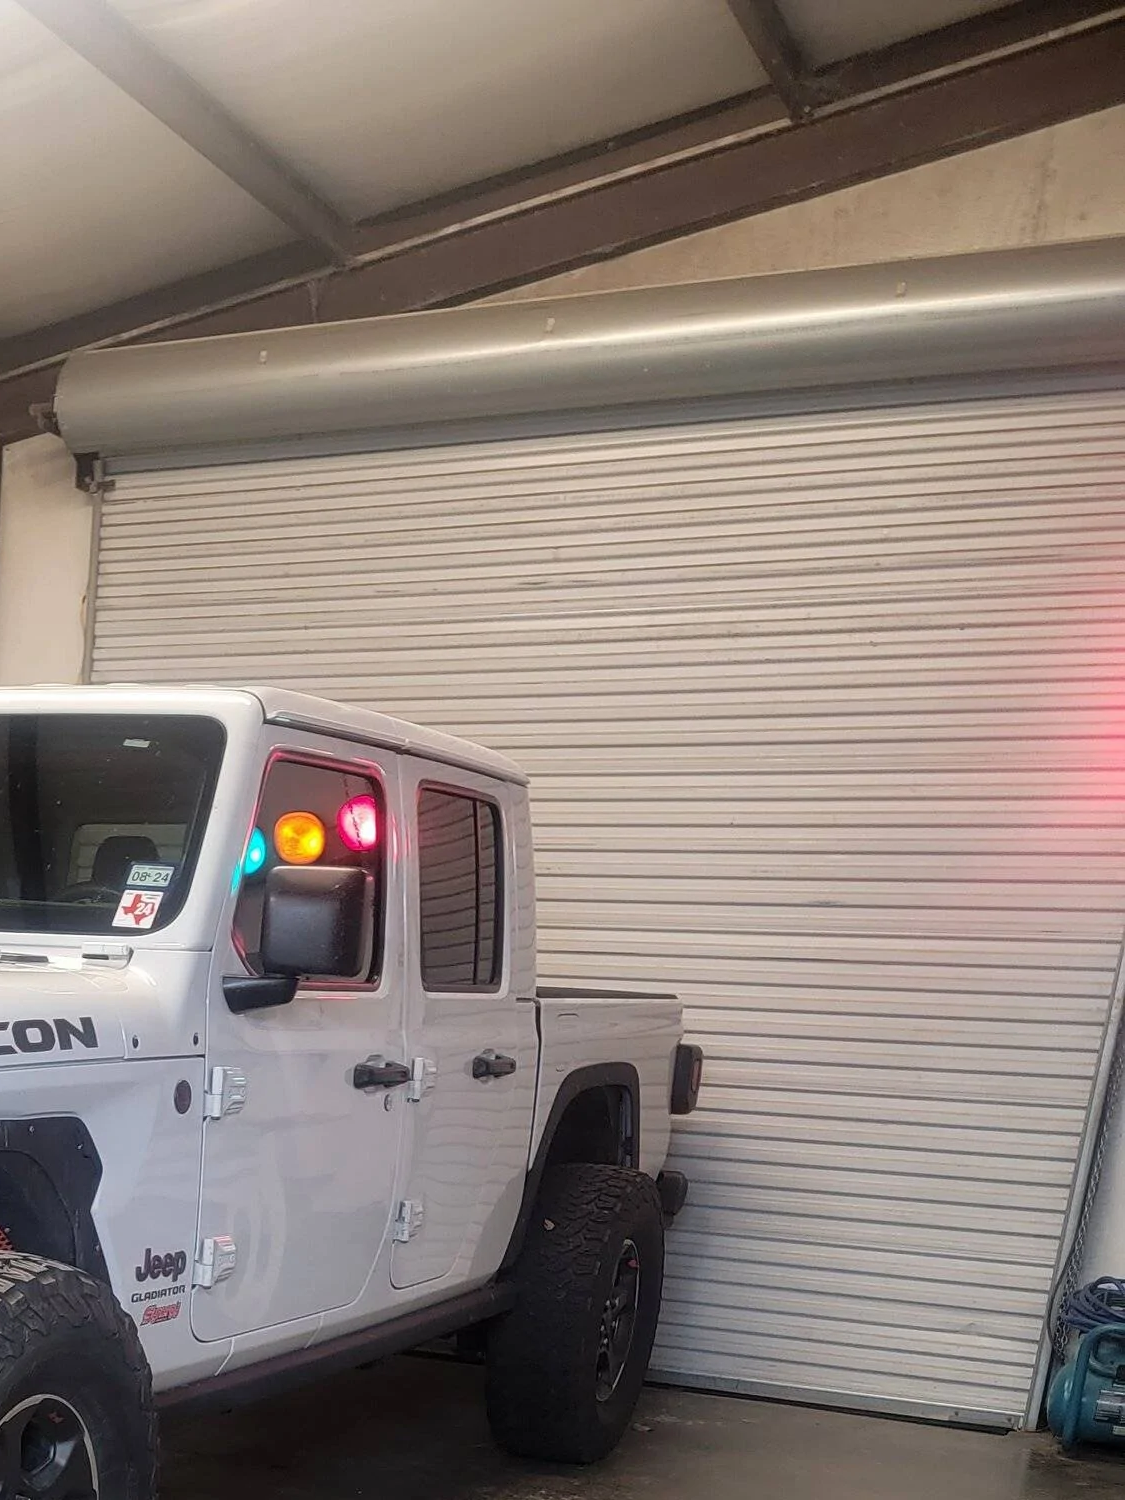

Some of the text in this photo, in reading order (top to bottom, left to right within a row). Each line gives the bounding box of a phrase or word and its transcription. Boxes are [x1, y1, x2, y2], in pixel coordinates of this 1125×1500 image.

[133, 902, 153, 916] 24
[135, 1247, 187, 1282] Jeep
[131, 1285, 186, 1303] GLADIATOR
